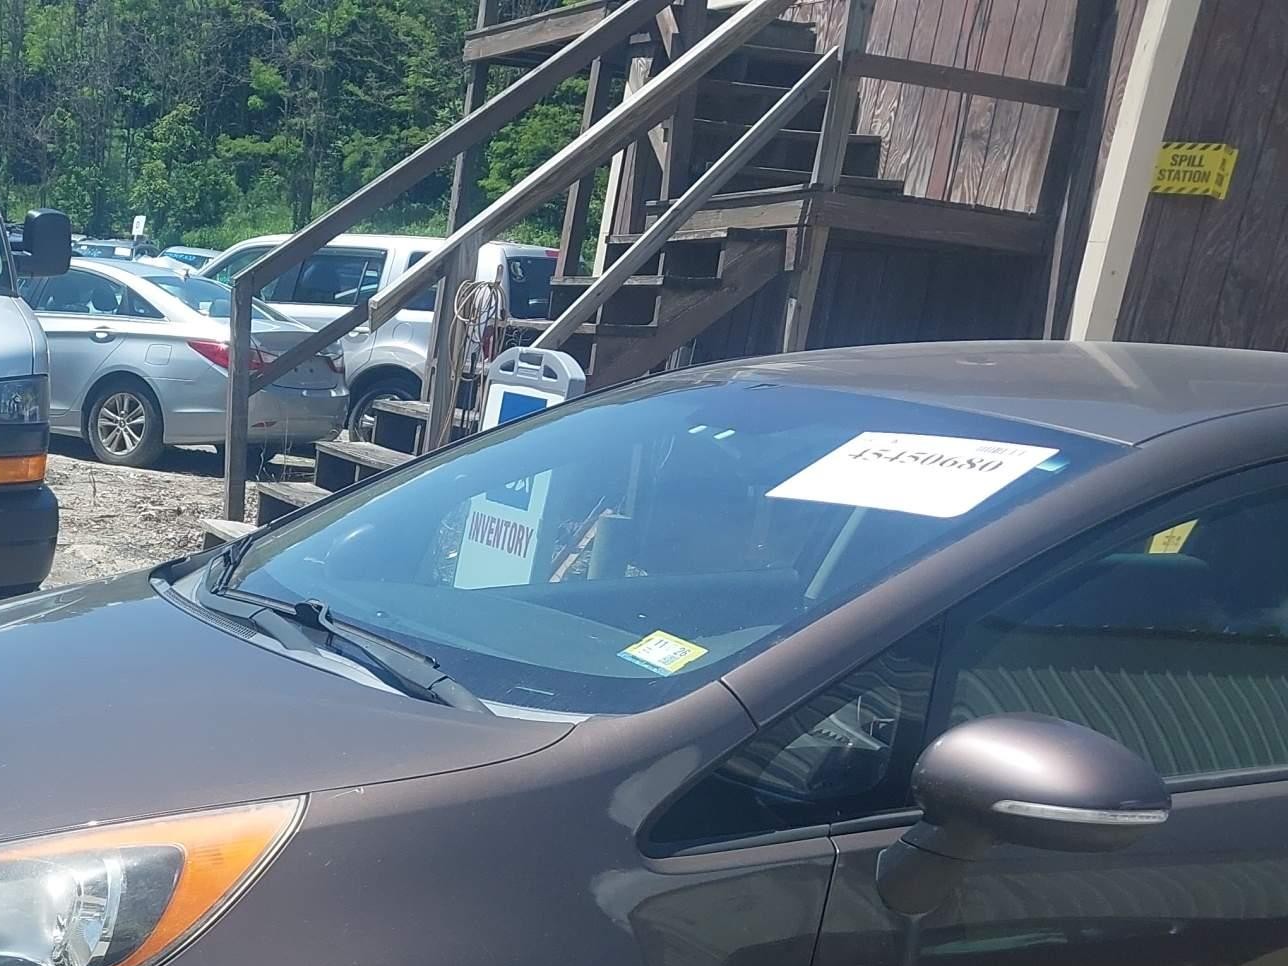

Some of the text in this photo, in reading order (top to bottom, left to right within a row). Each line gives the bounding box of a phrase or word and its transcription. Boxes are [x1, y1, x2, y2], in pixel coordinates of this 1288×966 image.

[1170, 153, 1205, 168] SPILL
[1156, 168, 1212, 184] STATION
[848, 448, 1004, 472] 45450680
[469, 511, 534, 559] INVENTORY
